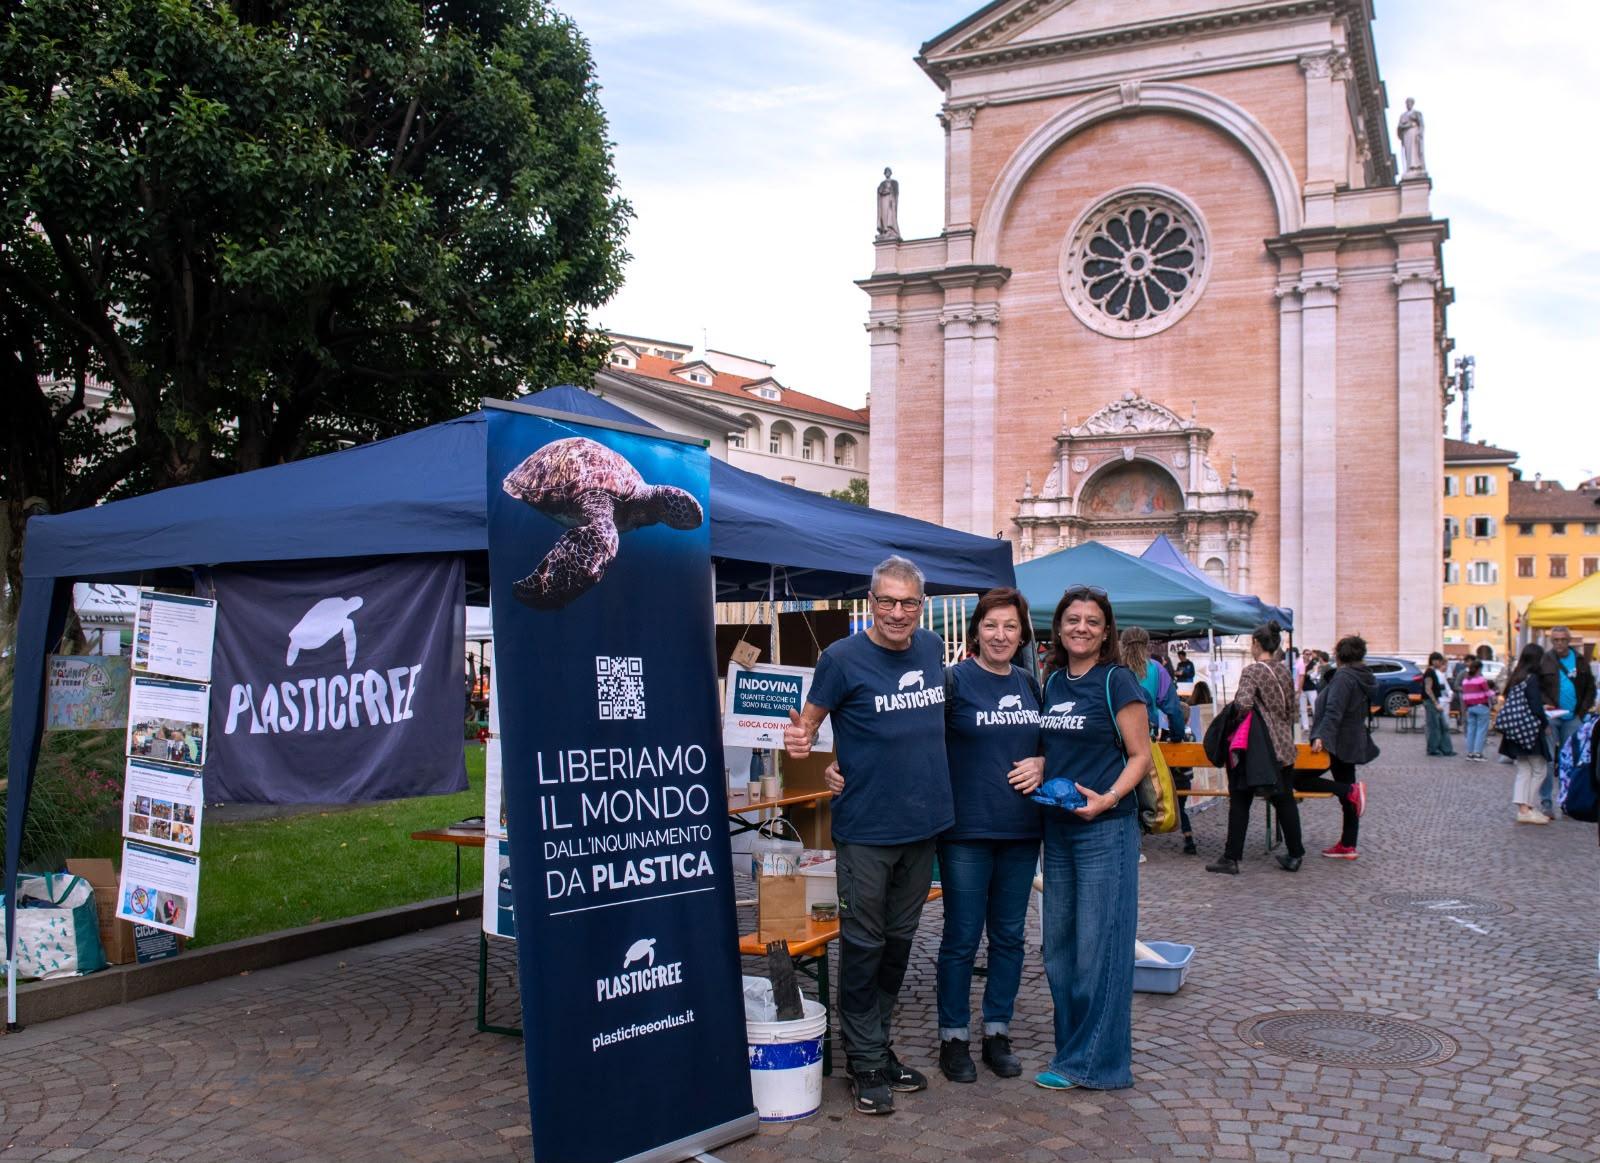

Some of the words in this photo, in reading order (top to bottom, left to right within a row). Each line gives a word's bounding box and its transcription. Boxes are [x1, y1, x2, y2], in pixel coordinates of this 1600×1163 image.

[80, 615, 125, 623] XLMOTO
[224, 663, 422, 735] PLASTICFREE
[738, 678, 799, 694] INDOVINA
[740, 693, 765, 702] QUANTE
[765, 695, 788, 704] CICCHE
[742, 701, 759, 709] SONO
[738, 720, 761, 728] GIOCA
[762, 721, 779, 730] CON
[537, 745, 707, 785] LIBERIAMO
[541, 795, 573, 831] IL
[581, 784, 710, 827] MONDO
[544, 824, 712, 860] DALL'INQUINAMENTO
[546, 867, 586, 899] DA
[592, 850, 715, 893] PLASTICA
[596, 961, 683, 1003] PLASTICFREE
[592, 1009, 695, 1052] plasticfreeonlus.it
